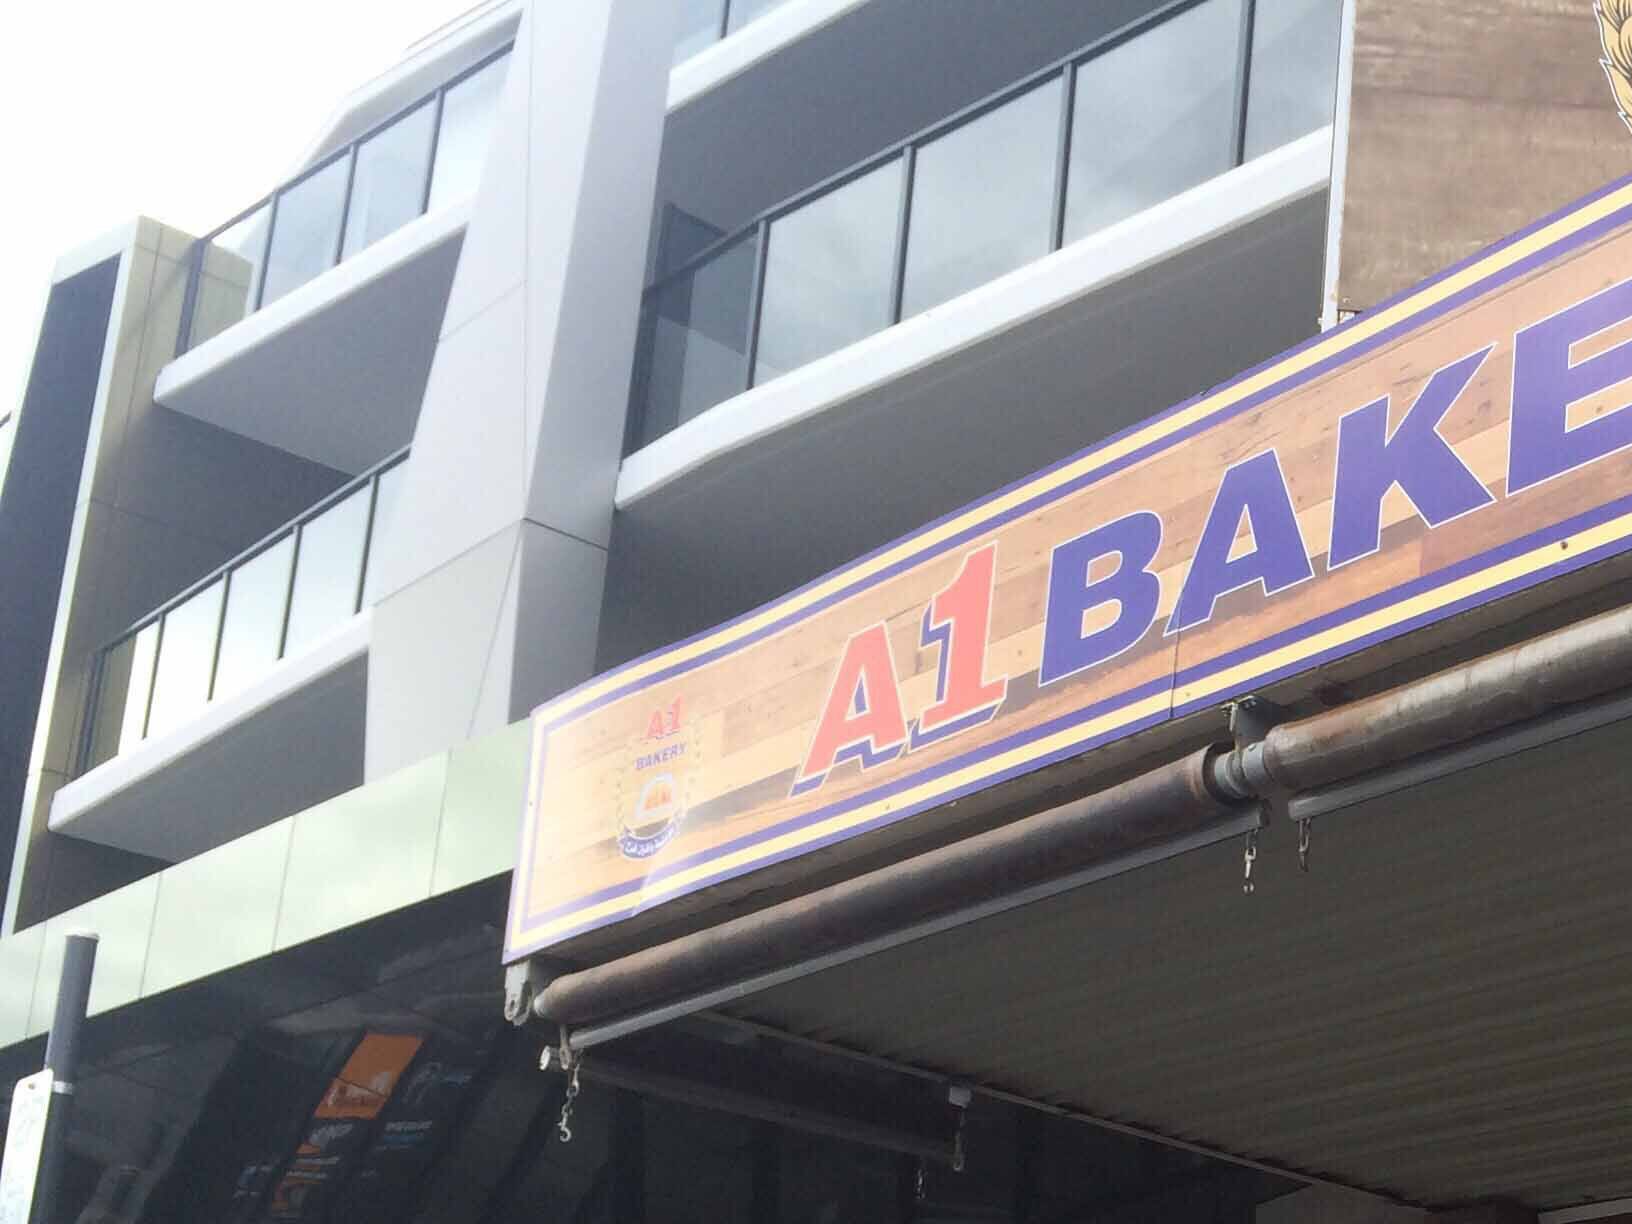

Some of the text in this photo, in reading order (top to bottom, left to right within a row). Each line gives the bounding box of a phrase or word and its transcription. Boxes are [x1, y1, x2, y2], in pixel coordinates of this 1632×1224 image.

[787, 540, 1008, 799] A1
[641, 690, 684, 743] A1
[634, 741, 688, 771] BAKERY
